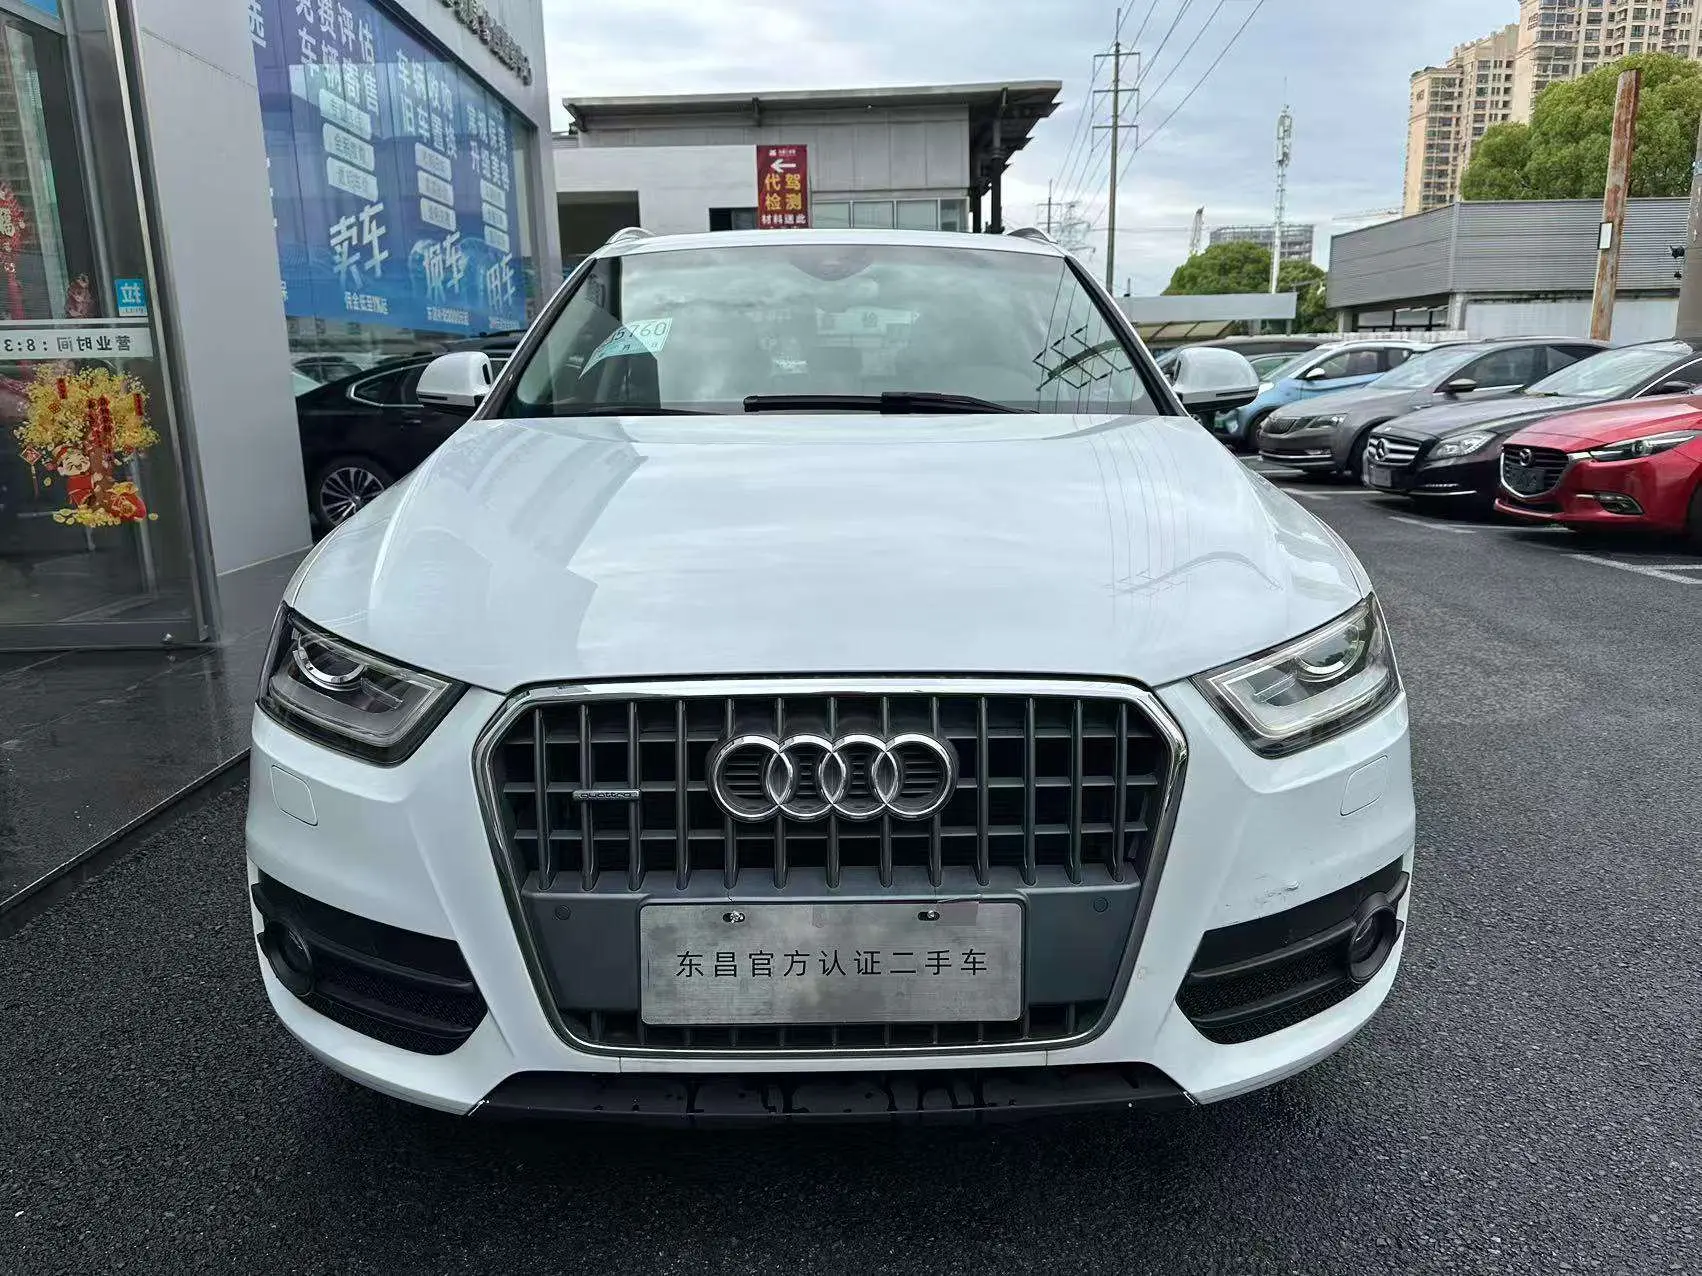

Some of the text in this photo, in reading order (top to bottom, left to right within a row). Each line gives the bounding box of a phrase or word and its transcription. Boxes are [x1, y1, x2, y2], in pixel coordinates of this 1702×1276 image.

[765, 173, 801, 191] 代驾
[765, 193, 802, 210] 检测
[329, 202, 389, 289] 卖车
[675, 949, 988, 978] 东昌官方认证二手车
